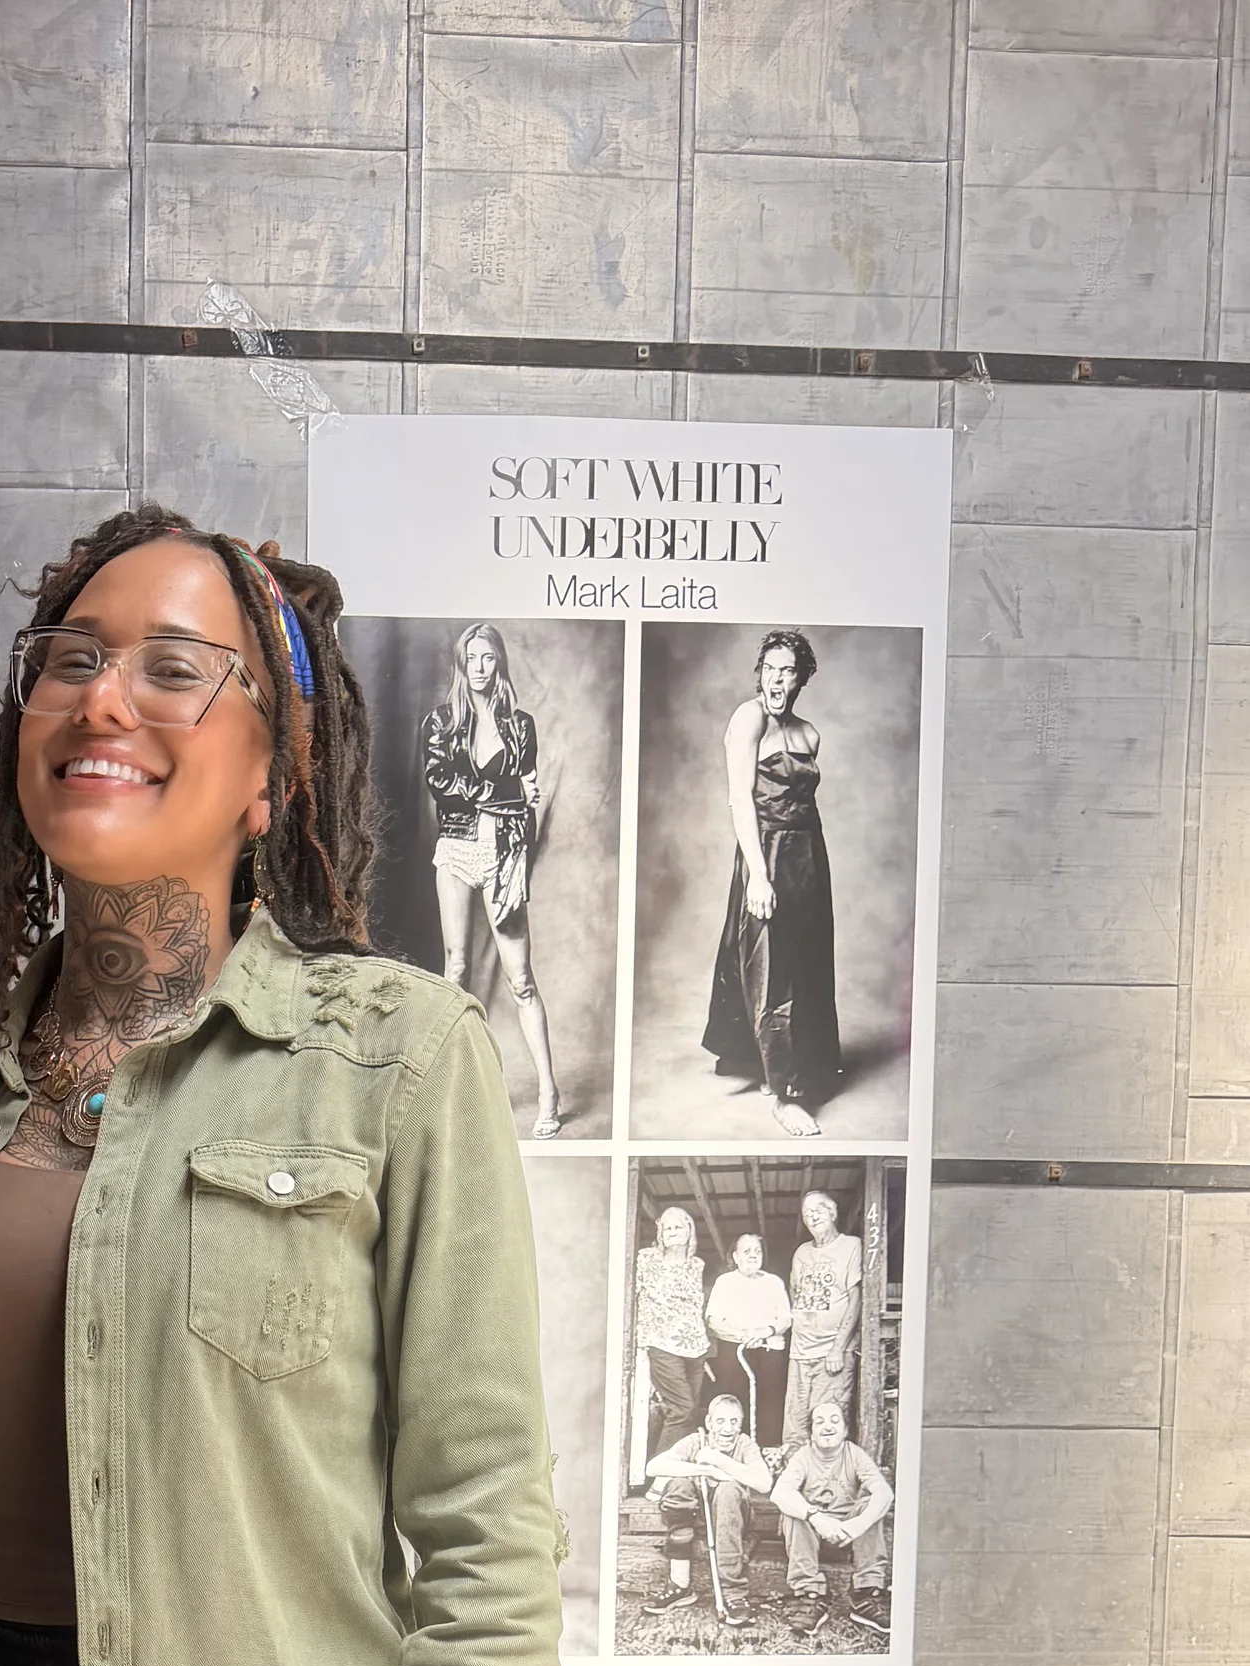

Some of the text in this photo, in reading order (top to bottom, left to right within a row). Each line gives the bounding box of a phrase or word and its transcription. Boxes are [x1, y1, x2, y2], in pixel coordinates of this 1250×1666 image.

[488, 456, 783, 505] SOFT WHITE
[488, 515, 781, 563] UNDERBELLY
[546, 573, 718, 610] Mark Laita
